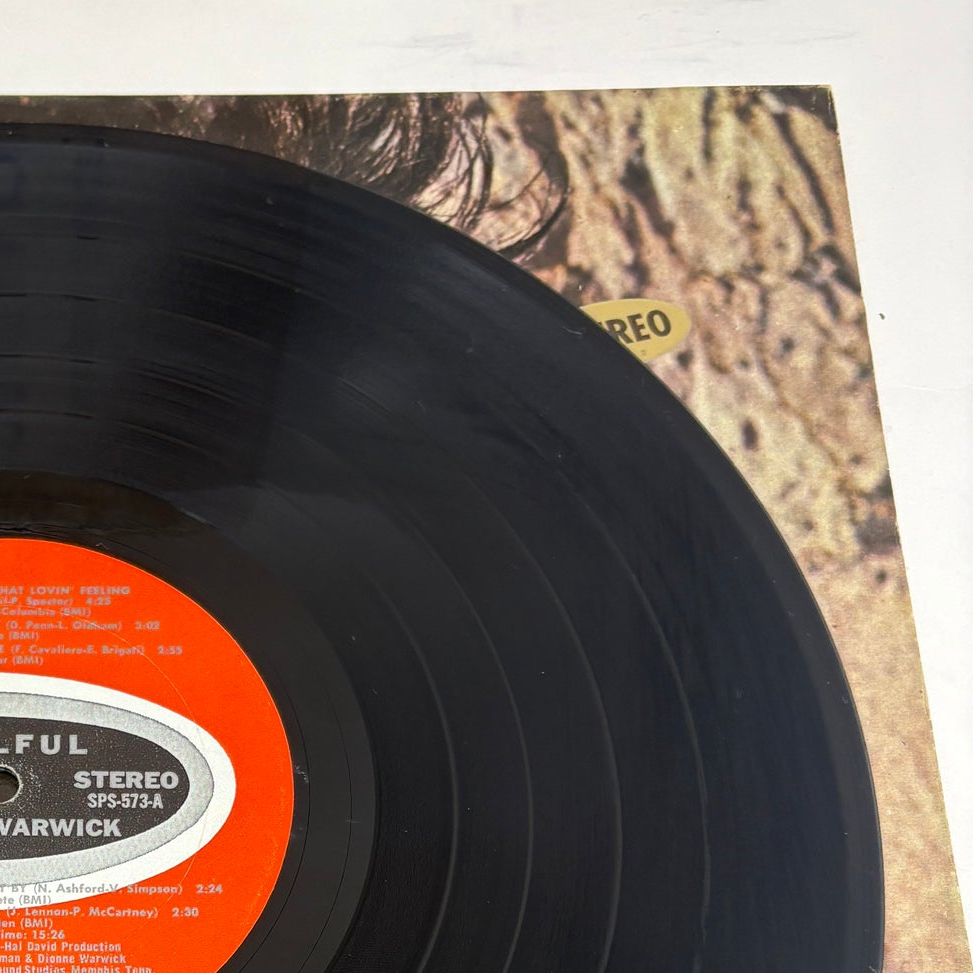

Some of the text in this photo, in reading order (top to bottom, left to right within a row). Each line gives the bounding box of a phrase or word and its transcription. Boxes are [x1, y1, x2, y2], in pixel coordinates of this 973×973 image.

[597, 309, 672, 344] REO
[30, 585, 74, 595] LOVIN'
[80, 586, 131, 595] FEELING
[59, 607, 91, 617] (BMI)
[9, 631, 40, 641] (BMI)
[12, 655, 44, 666] (BMI)
[73, 770, 179, 790] STEREO
[86, 793, 164, 810] SPS-573-A
[11, 883, 26, 893] BY
[33, 883, 52, 895] (N.
[55, 883, 123, 894] Ashford-V.
[127, 883, 183, 895] Simpson)
[196, 884, 223, 894] 2:24
[18, 894, 52, 906] (BMI)
[88, 907, 159, 918] McCartney)
[171, 907, 199, 917] 2:30
[20, 918, 54, 929] (BMI)
[32, 929, 66, 939] 15:26
[27, 941, 57, 952] David
[61, 941, 122, 952] Production
[25, 953, 33, 964] &
[37, 953, 75, 964] Dionne
[79, 953, 126, 964] Warwick
